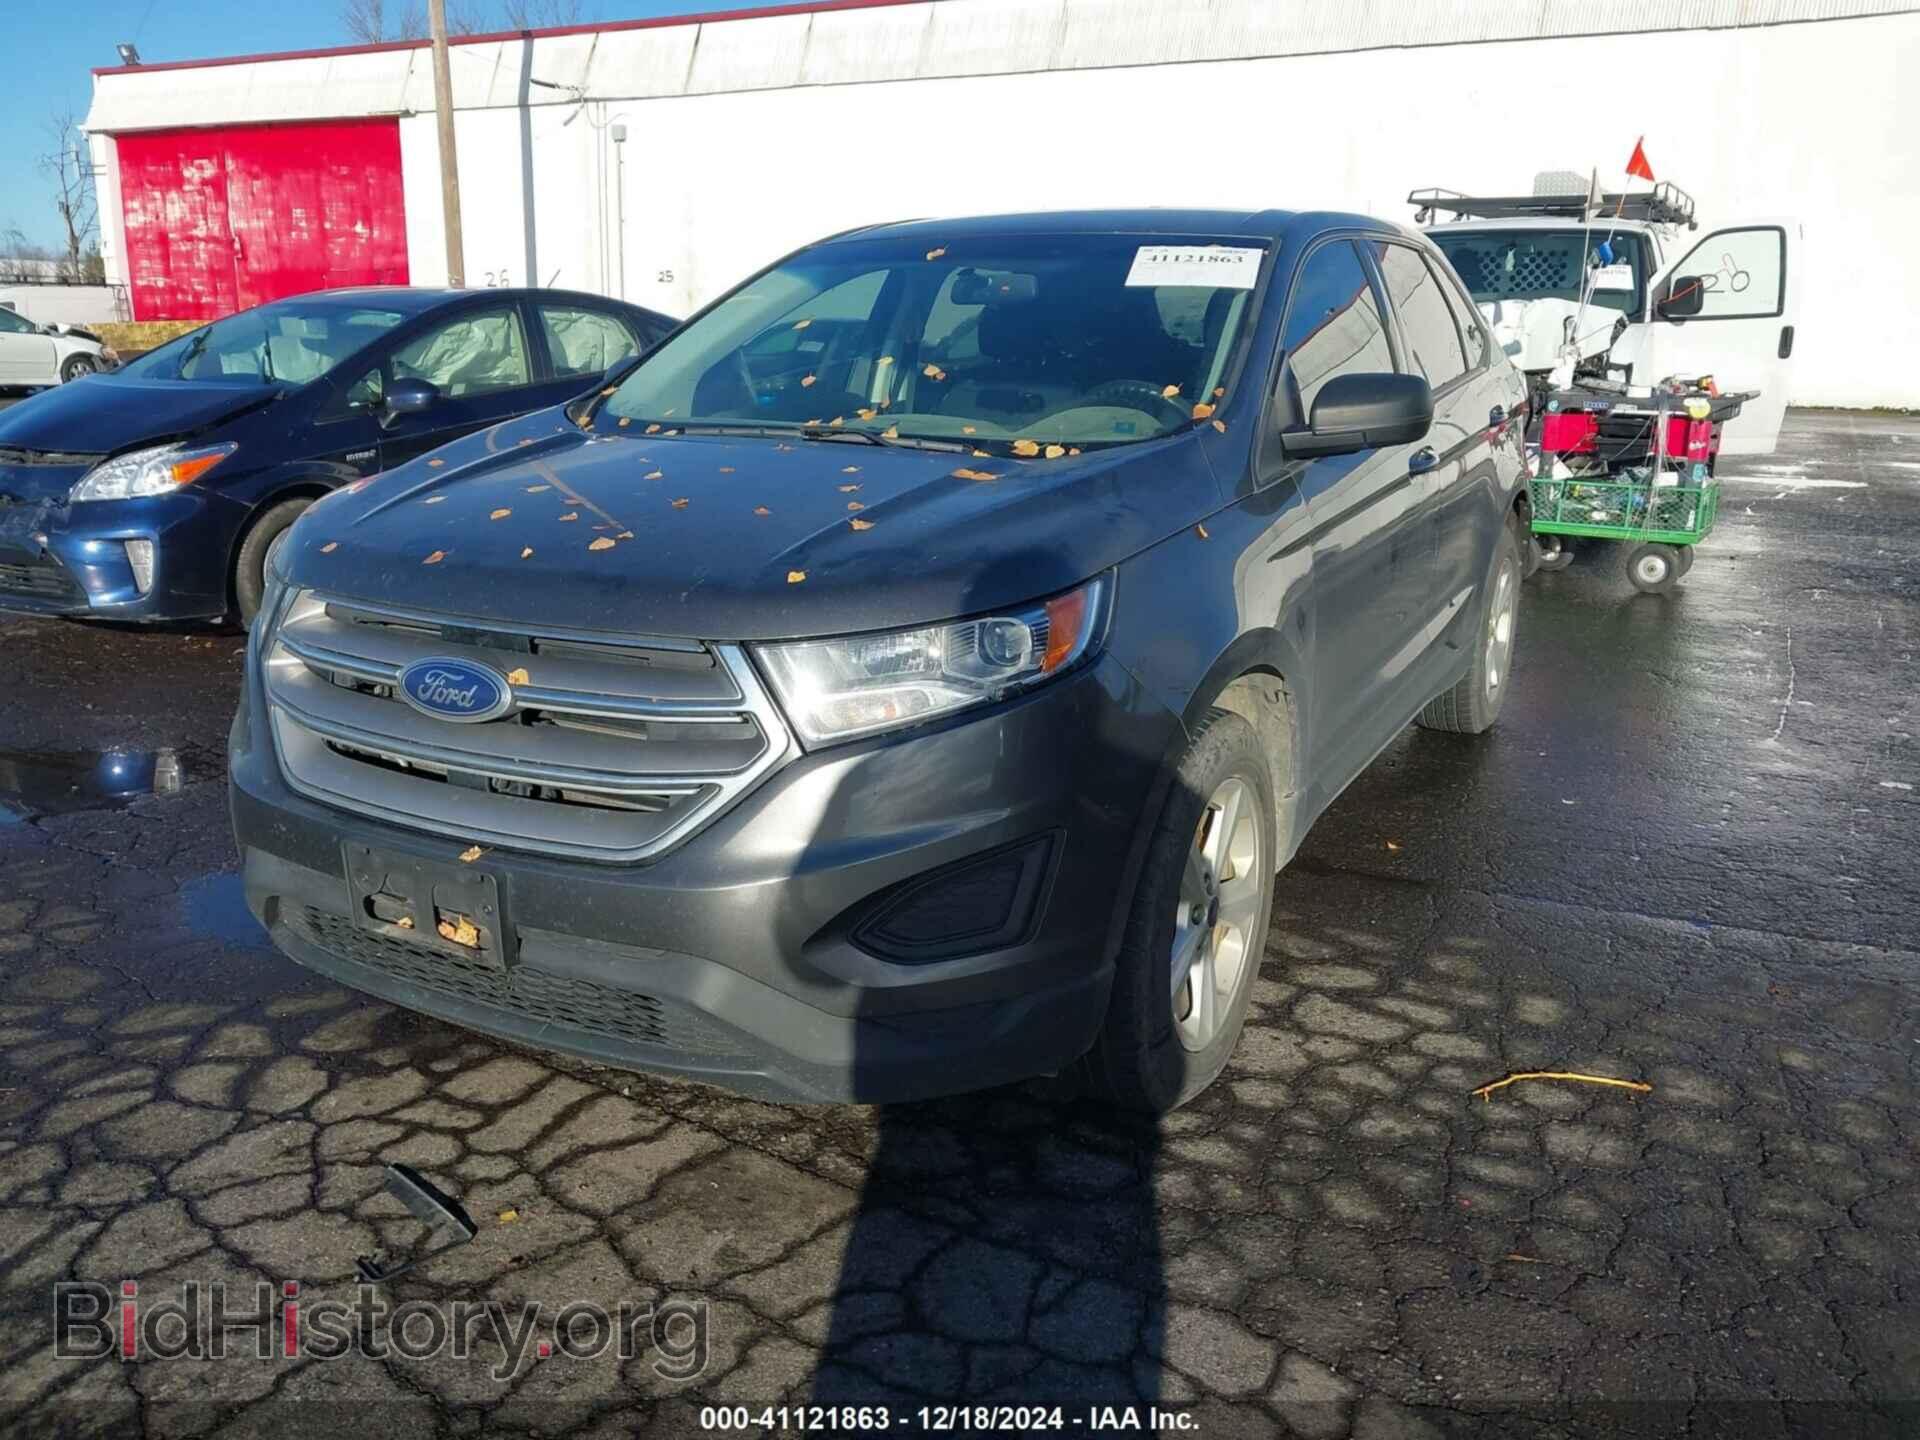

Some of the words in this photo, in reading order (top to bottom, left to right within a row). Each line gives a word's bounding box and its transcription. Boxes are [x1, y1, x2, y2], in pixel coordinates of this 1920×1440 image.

[1145, 253, 1244, 264] 41121863
[484, 268, 511, 288] 26
[657, 270, 674, 283] 25
[417, 669, 479, 708] Ford
